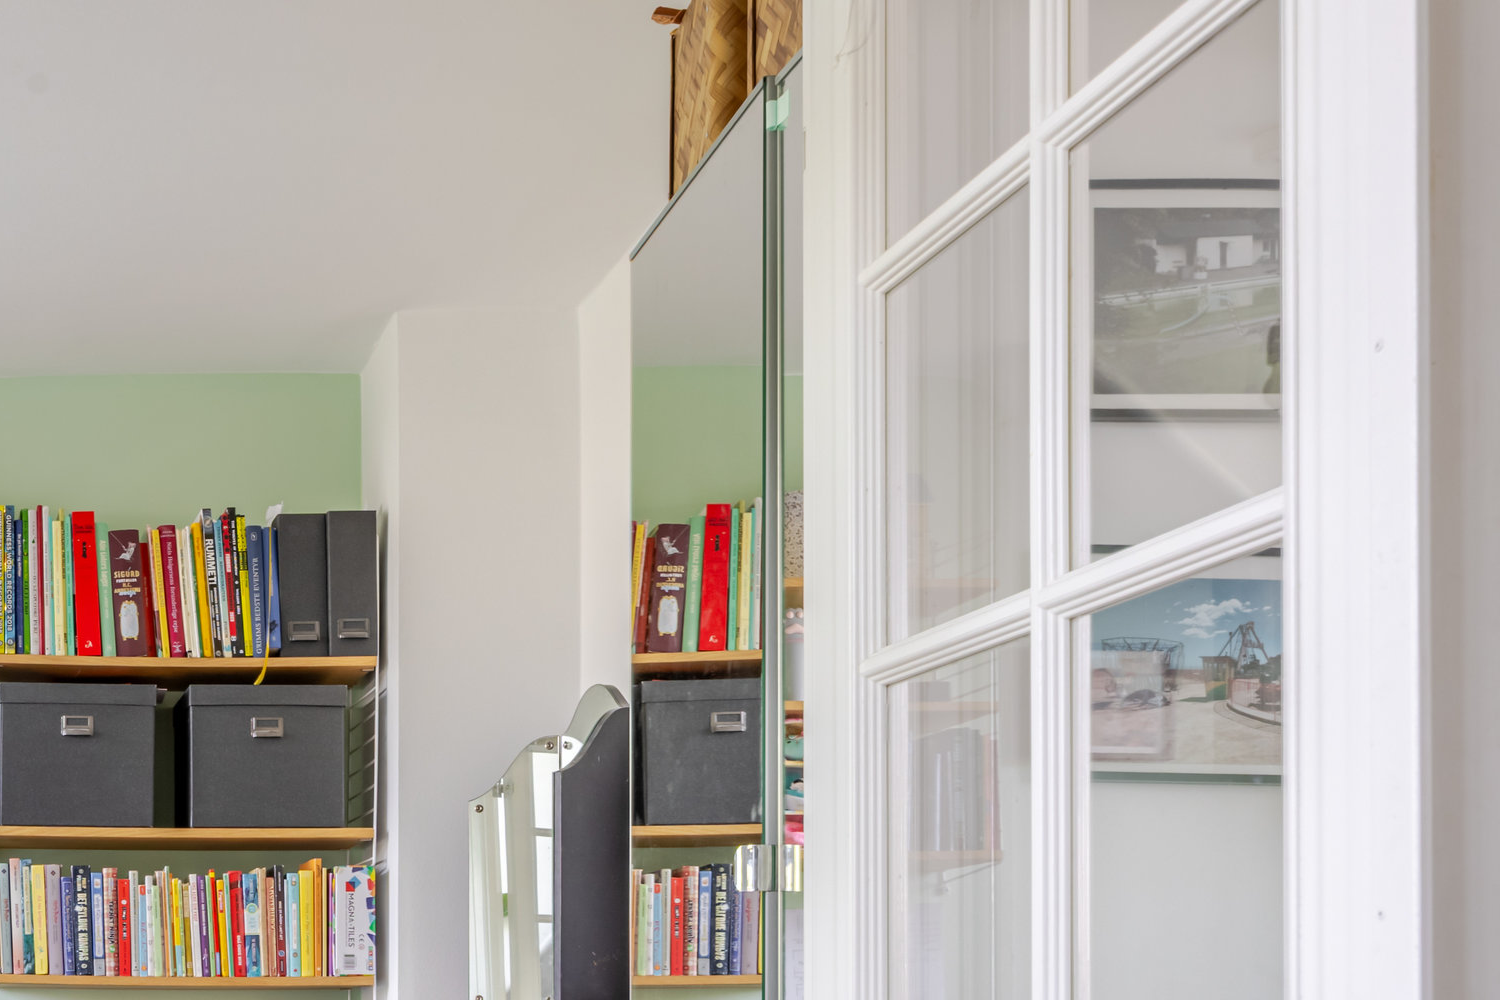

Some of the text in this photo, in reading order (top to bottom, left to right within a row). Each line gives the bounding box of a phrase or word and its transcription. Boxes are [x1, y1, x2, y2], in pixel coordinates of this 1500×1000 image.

[114, 570, 140, 578] SIGURD
[167, 556, 175, 586] Holgersens
[252, 558, 260, 591] EVENTYR
[254, 592, 262, 622] BEDSTE
[77, 893, 89, 961] DET GYLDNE KOMPAS
[107, 926, 115, 945] NINJA
